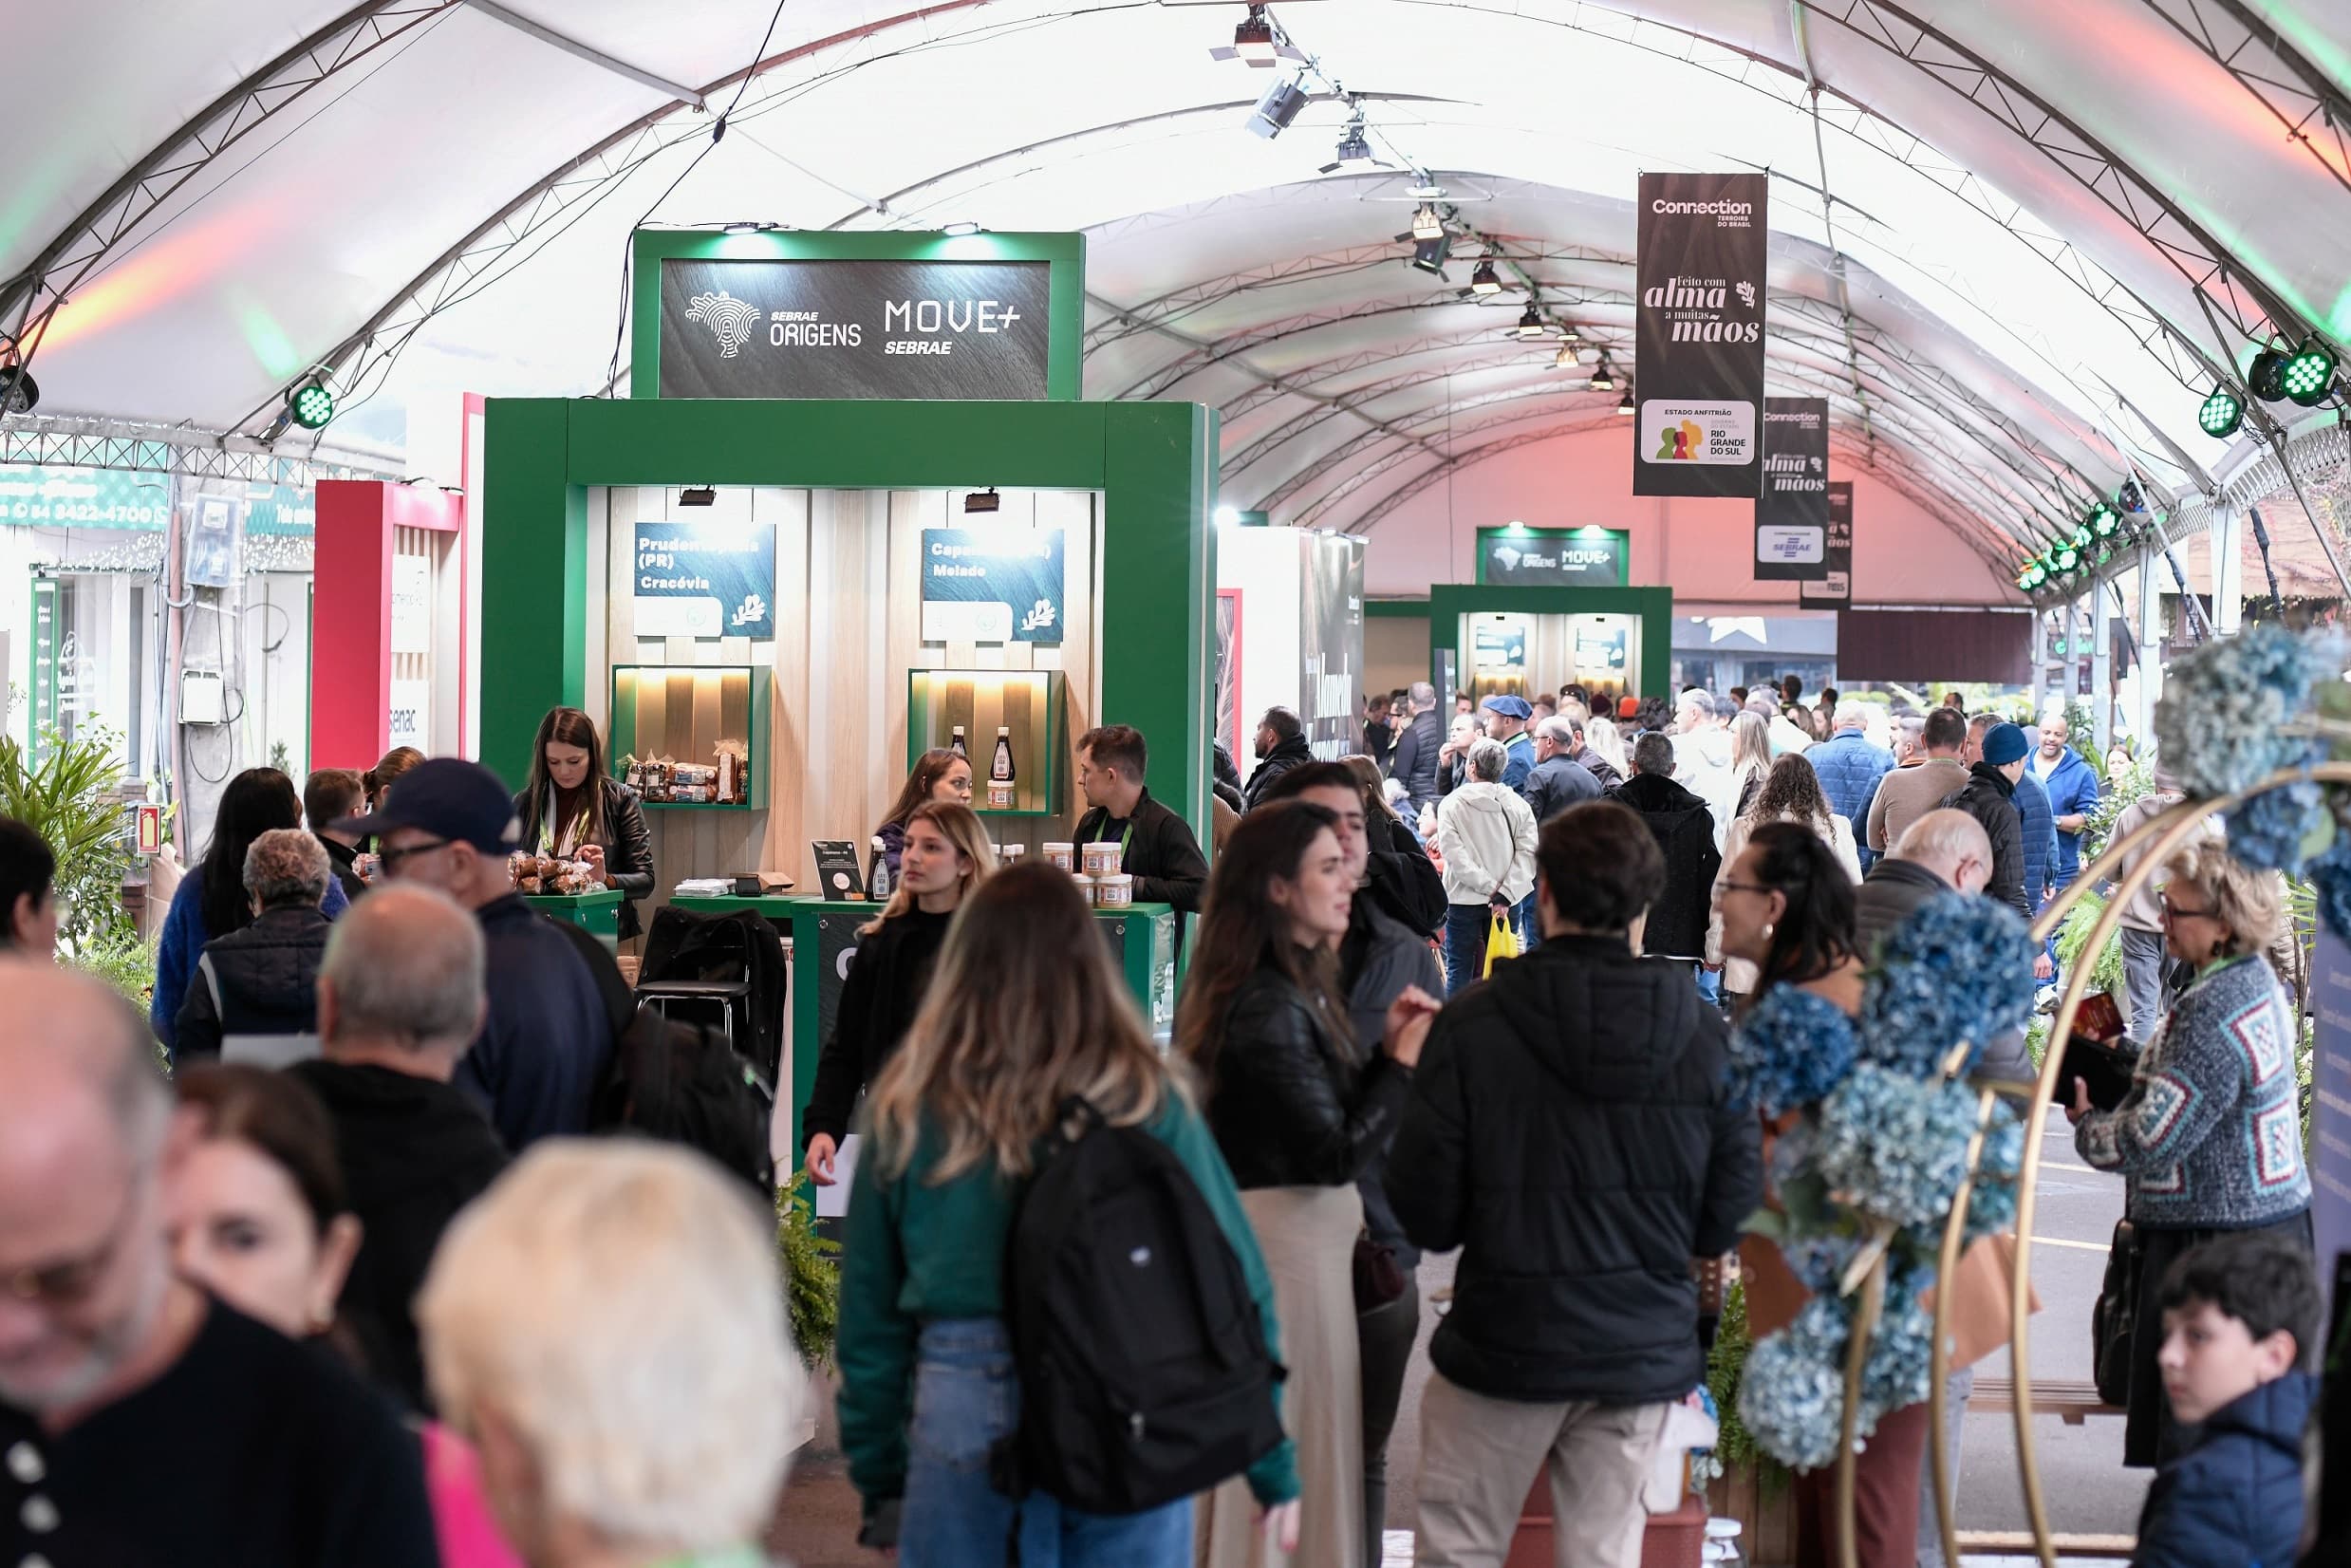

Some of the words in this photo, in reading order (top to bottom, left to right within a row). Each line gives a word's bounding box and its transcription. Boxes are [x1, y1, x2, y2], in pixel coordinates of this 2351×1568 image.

[1652, 198, 1752, 215] Connection
[1704, 278, 1726, 287] com
[1644, 278, 1726, 308] alma
[771, 311, 819, 322] SEBRAE
[885, 300, 1021, 333] MOVE+
[1665, 311, 1671, 320] a
[1674, 309, 1709, 320] muitas
[770, 323, 862, 347] ORIGENS
[1671, 314, 1760, 343] mãos
[884, 341, 952, 355] SEBRAE
[1710, 439, 1745, 447] GRANDE
[1710, 447, 1724, 456] DO
[1725, 447, 1742, 456] SUL
[1774, 475, 1826, 492] mãos
[638, 553, 675, 570] (PR)
[641, 576, 710, 589] Cracóvia
